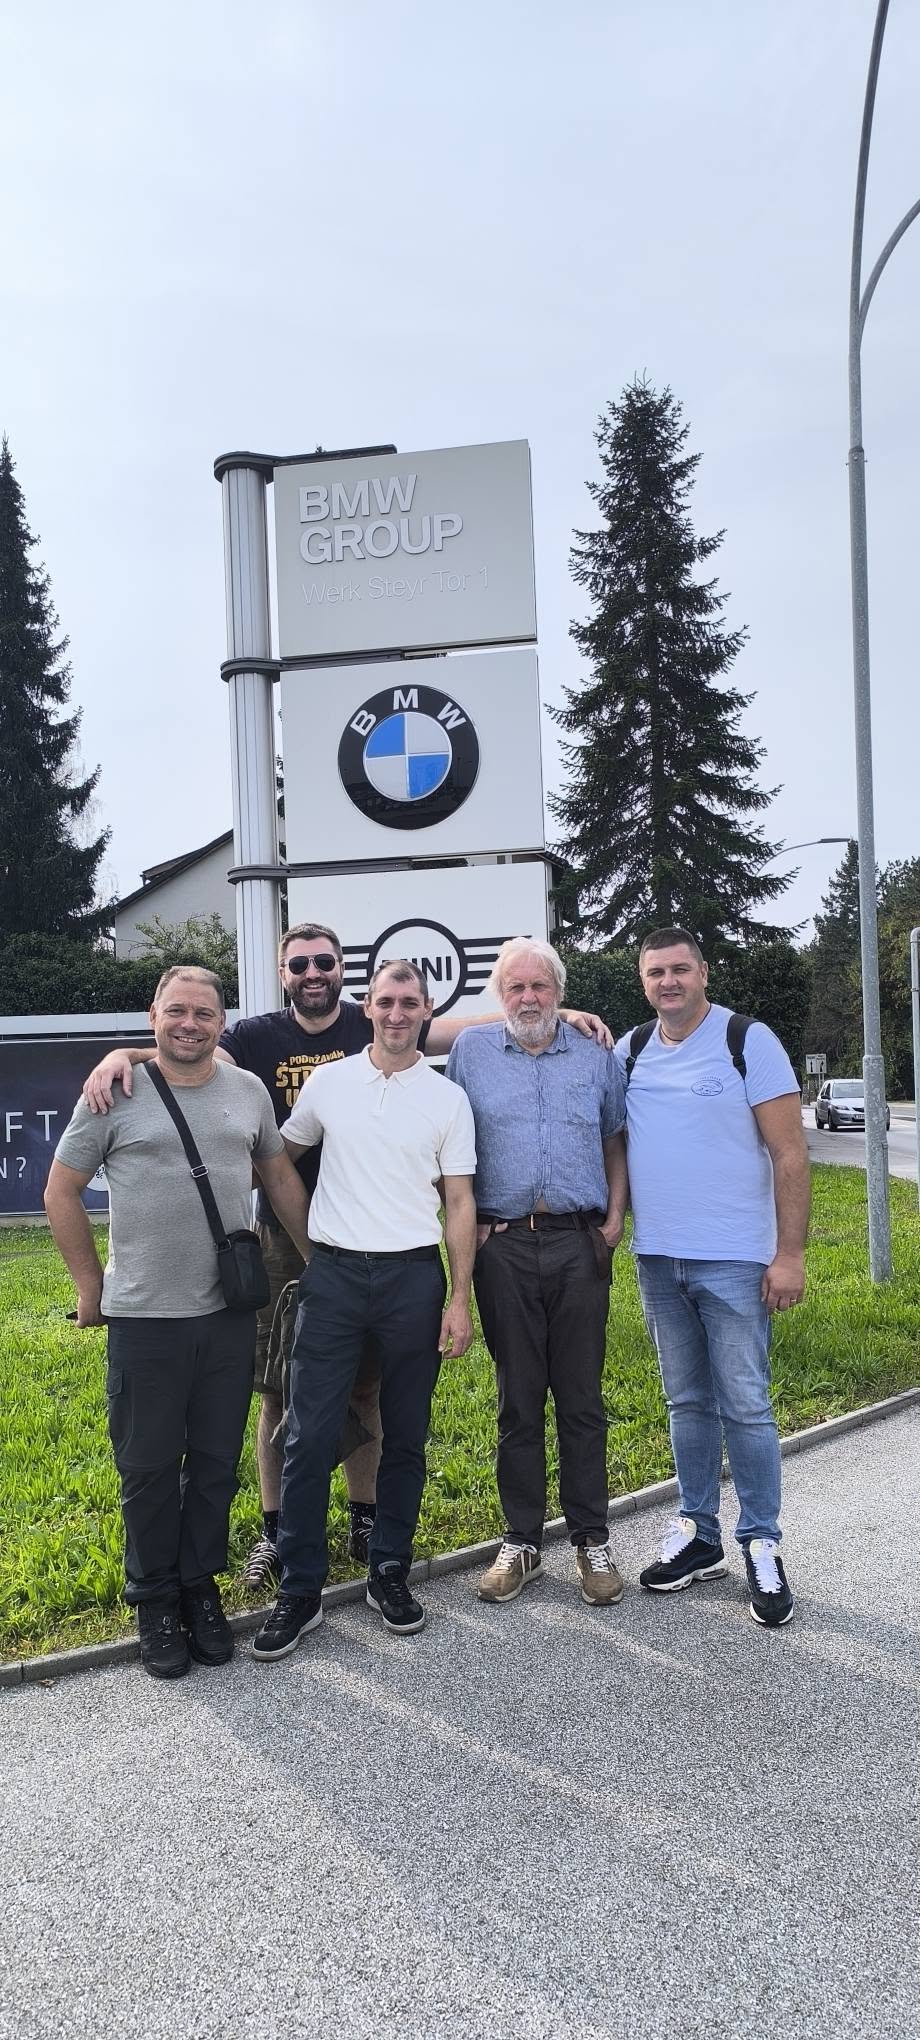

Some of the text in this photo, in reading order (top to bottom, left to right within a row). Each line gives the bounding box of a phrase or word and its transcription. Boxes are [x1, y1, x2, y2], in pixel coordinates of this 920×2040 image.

[299, 474, 417, 523] BMW
[299, 513, 463, 564] GROUP
[302, 565, 489, 605] Werk Steyr Tor 1
[350, 688, 467, 737] BMW
[382, 956, 452, 981] NI
